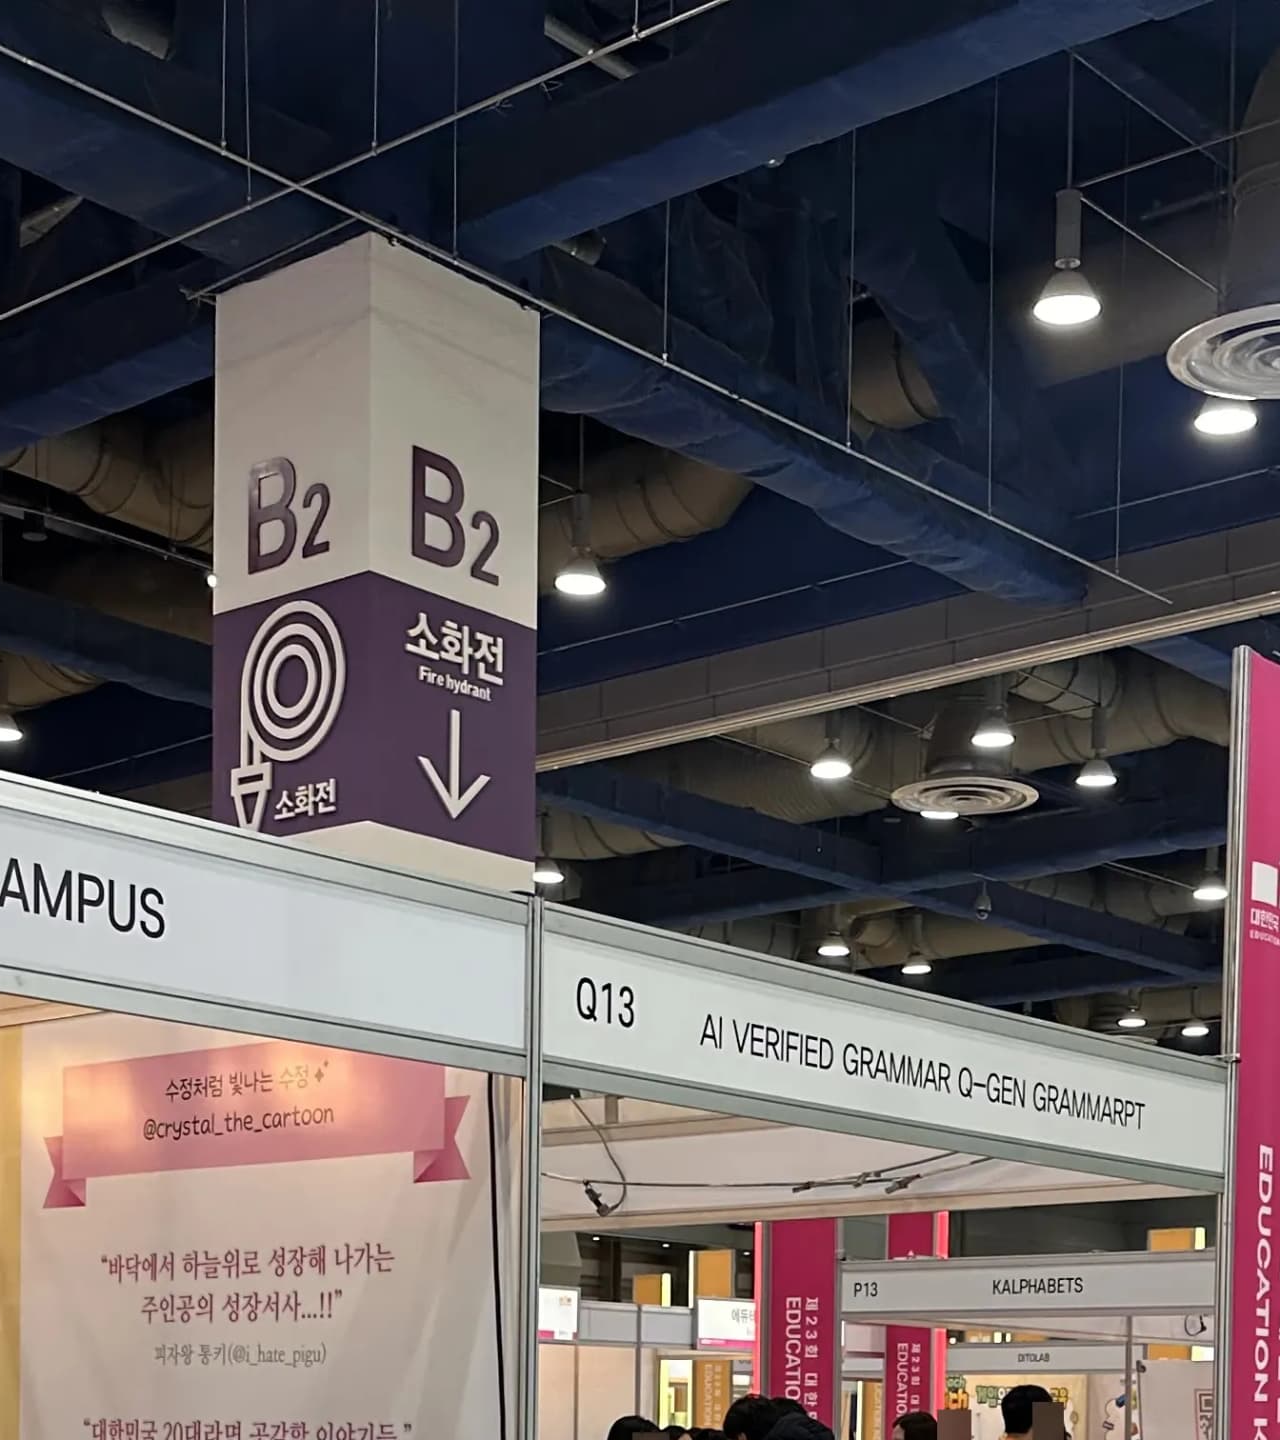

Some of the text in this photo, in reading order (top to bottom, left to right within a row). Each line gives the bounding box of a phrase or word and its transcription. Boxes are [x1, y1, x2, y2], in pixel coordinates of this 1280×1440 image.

[248, 455, 332, 575] B2
[411, 444, 501, 587] B2
[404, 611, 504, 687] 소화전
[418, 664, 492, 702] Fire hydrant
[272, 777, 337, 821] 소화전
[575, 975, 636, 1028] Q13
[164, 1073, 224, 1103] 수정처럼
[228, 1070, 274, 1097] 빛나는
[698, 1012, 1146, 1131] AI VERIFIED GRAMMAR Q-GEN GRAMMARPT
[142, 1105, 335, 1142] @crystal_the_cartoon
[181, 1249, 262, 1280] 하늘위로
[267, 1245, 327, 1277] 성장해
[333, 1242, 396, 1276] 나가는
[1254, 1144, 1274, 1403] EDUCATION
[853, 1281, 879, 1298] P13
[992, 1276, 1084, 1296] KALPHABETS
[140, 1292, 215, 1325] 주인공의
[804, 1297, 819, 1359] 제23회
